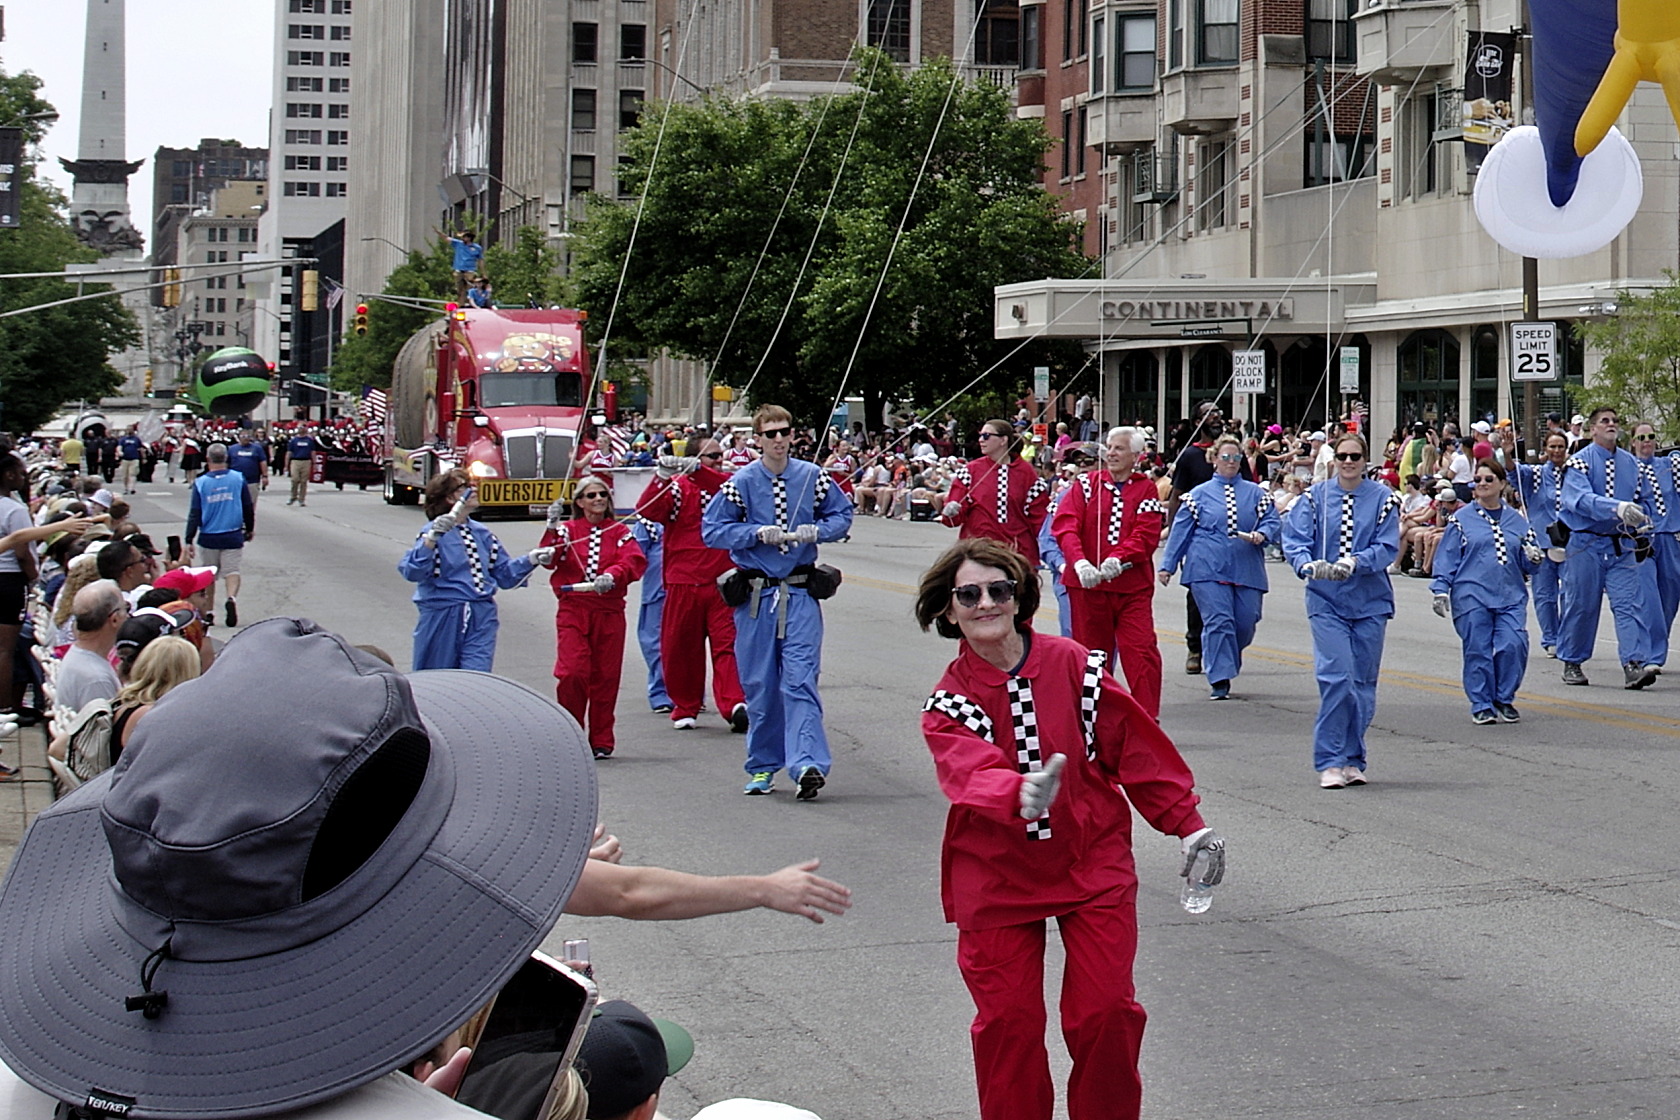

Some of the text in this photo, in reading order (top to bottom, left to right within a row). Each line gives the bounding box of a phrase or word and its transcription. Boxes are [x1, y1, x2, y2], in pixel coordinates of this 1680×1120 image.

[1102, 301, 1291, 319] CONTINENTAL
[1515, 330, 1552, 339] SPEED
[1519, 341, 1548, 351] LIMIT
[1235, 355, 1262, 365] DO NOT
[1517, 352, 1551, 373] 25
[1235, 367, 1263, 377] BLOCK
[1236, 379, 1262, 388] RAMP
[482, 483, 554, 502] OVERSIZE
